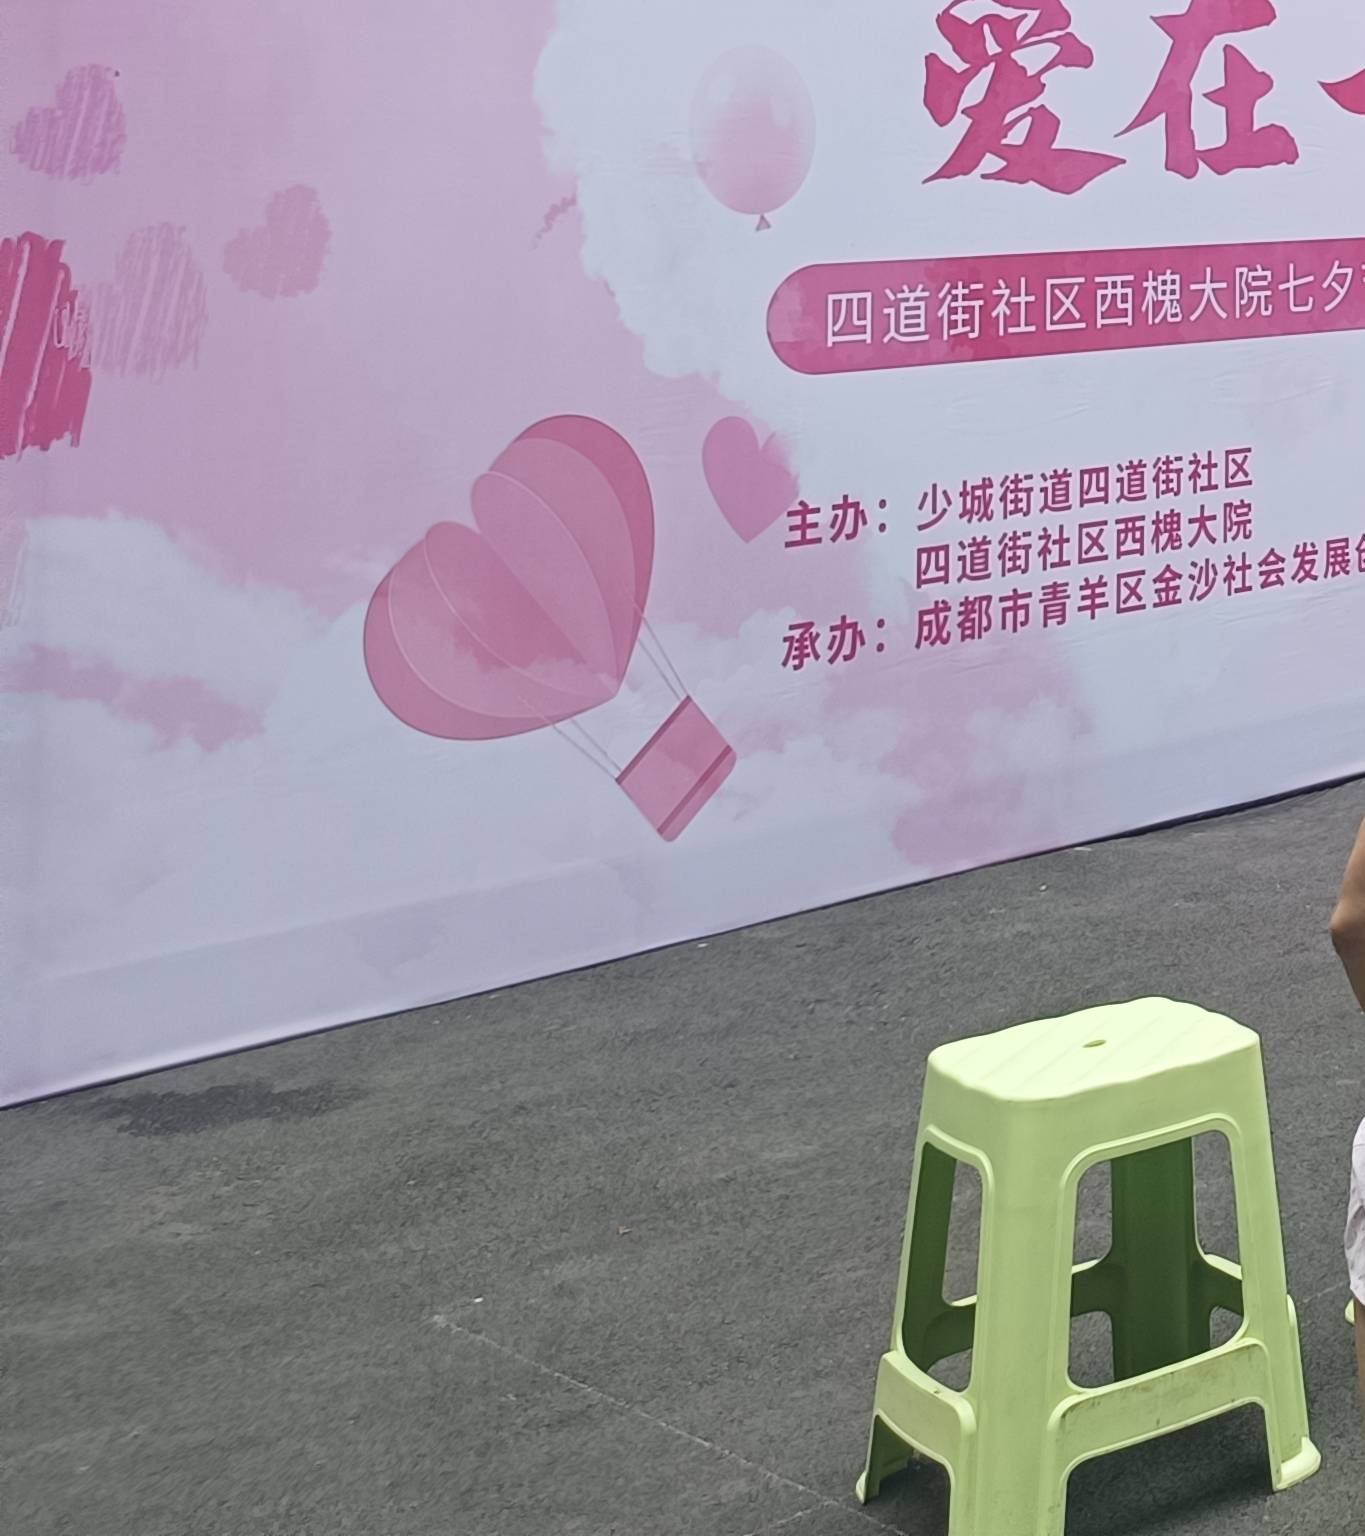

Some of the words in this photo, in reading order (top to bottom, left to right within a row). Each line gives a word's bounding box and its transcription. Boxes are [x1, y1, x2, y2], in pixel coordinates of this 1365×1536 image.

[916, 447, 1253, 531] 少城街道四道街社区
[915, 499, 1253, 589] 四道街社区西槐大院
